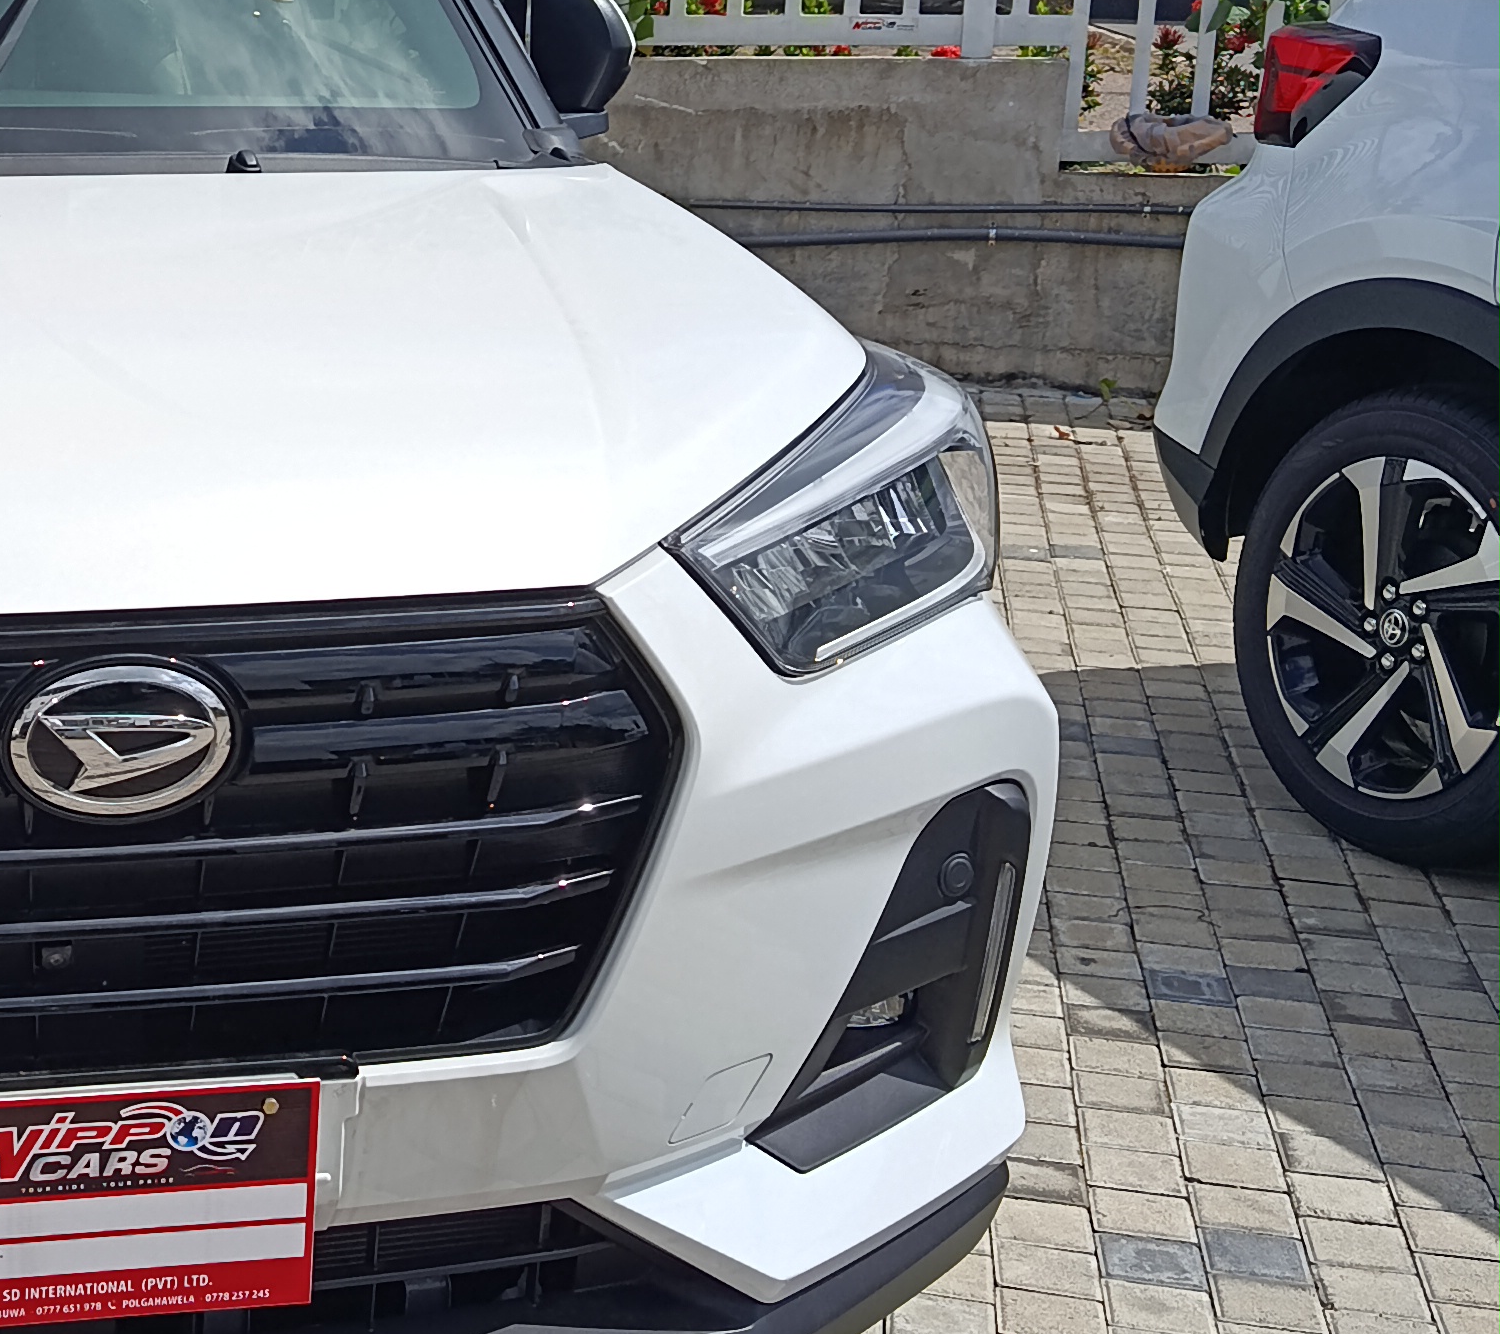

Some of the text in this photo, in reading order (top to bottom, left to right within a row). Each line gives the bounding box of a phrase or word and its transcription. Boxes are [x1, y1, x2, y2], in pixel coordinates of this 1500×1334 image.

[29, 1148, 171, 1181] CARS
[2, 1274, 213, 1302] SD INTERNATIONAL (PVT) LTD.
[36, 1305, 60, 1316] 0777
[83, 1301, 102, 1312] 978
[122, 1294, 195, 1309] POLGAHAWELA
[205, 1291, 229, 1303] 0778
[252, 1288, 270, 1299] 245
